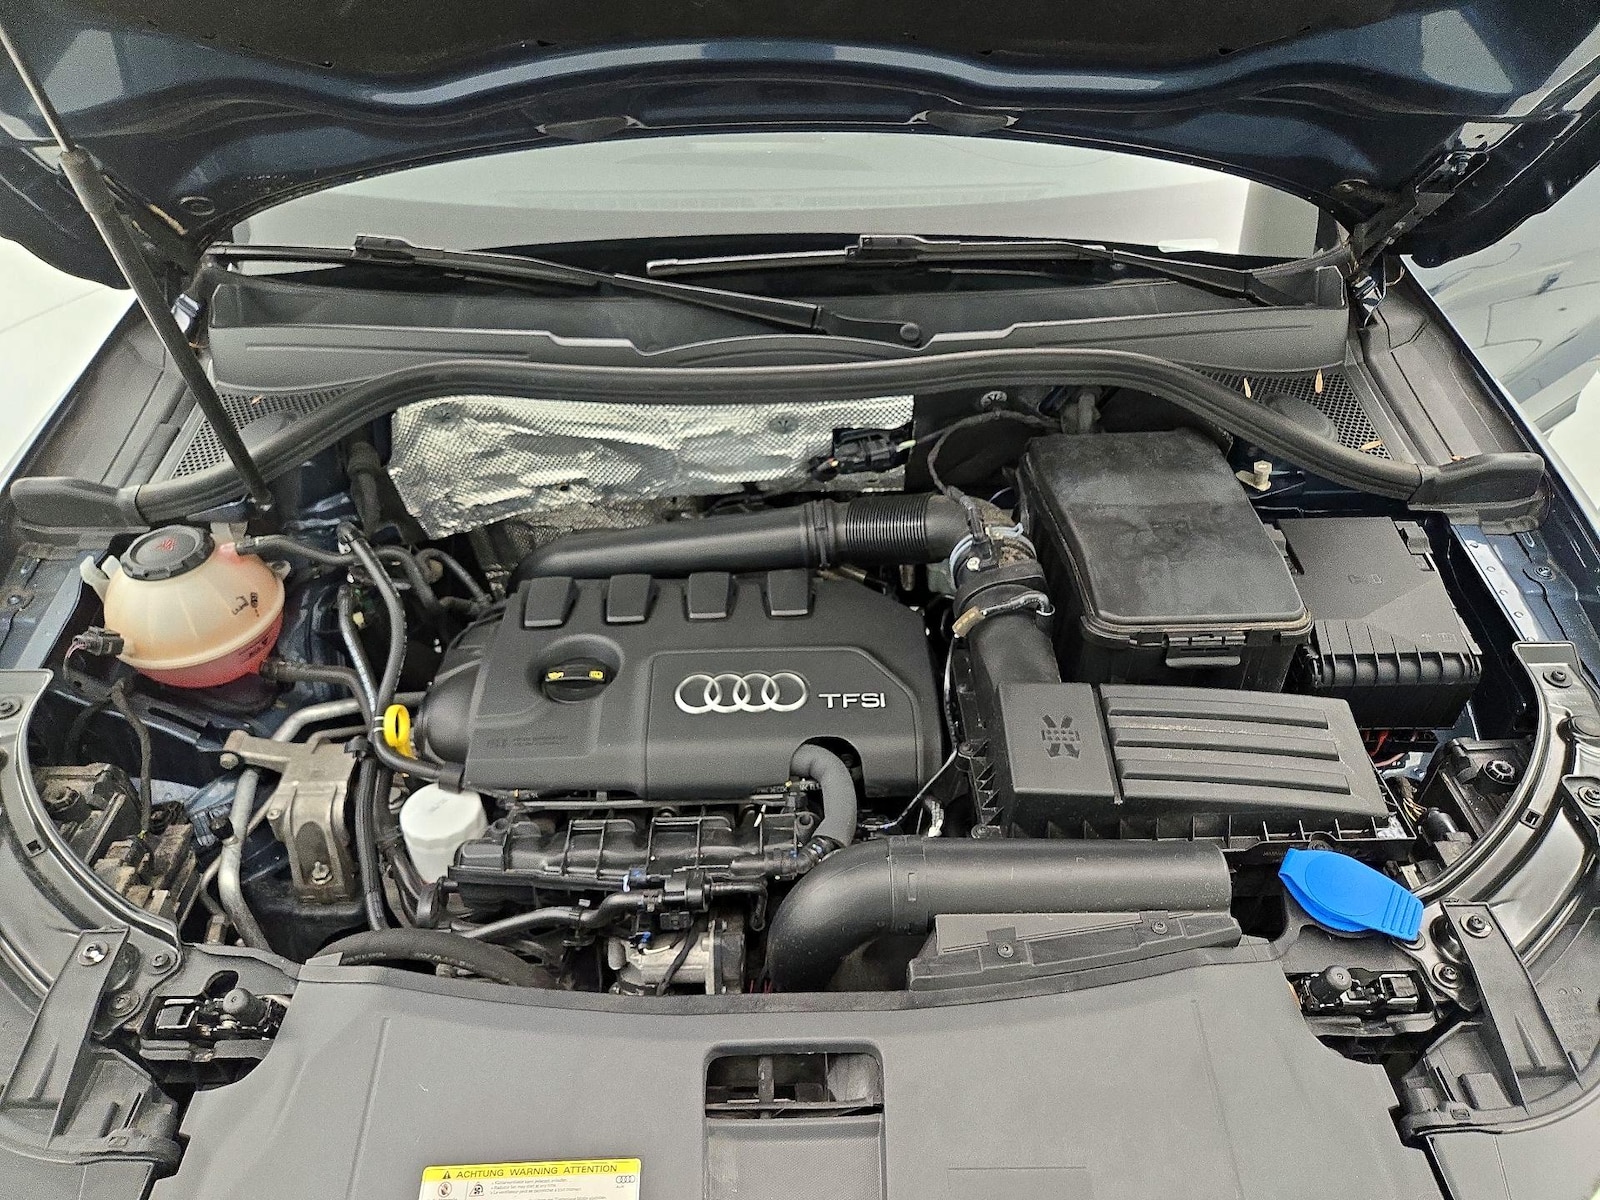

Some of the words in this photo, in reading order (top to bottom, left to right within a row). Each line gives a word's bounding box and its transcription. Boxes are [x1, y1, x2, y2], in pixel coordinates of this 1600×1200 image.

[818, 692, 886, 709] TFSI
[456, 1169, 504, 1179] ACHTUNG
[509, 1167, 558, 1176] WARNING
[562, 1165, 618, 1175] ATTENTION
